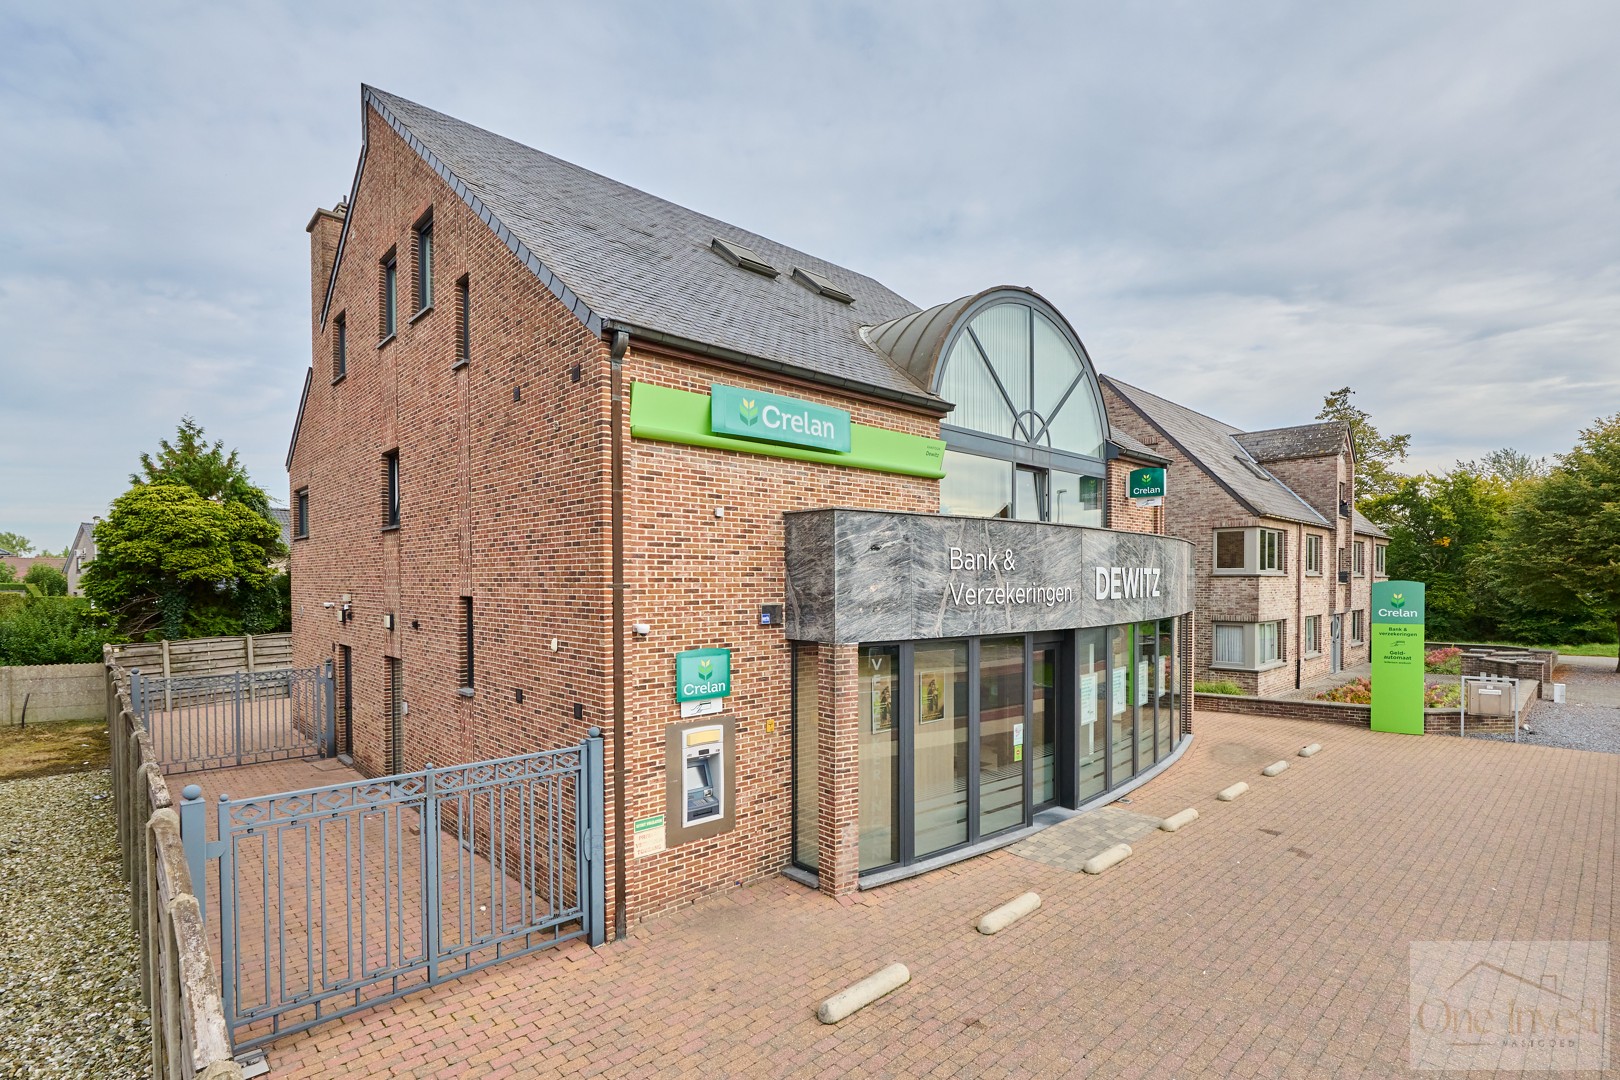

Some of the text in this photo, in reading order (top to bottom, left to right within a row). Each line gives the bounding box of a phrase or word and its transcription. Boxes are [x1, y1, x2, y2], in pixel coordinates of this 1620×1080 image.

[762, 405, 835, 440] Crelan
[1133, 486, 1161, 495] Crelan
[950, 547, 1016, 571] Bank &
[950, 582, 1073, 607] Verzekeringen
[1095, 566, 1161, 601] DEWITZ
[1378, 608, 1418, 618] Crelan
[683, 681, 726, 696] Crelan
